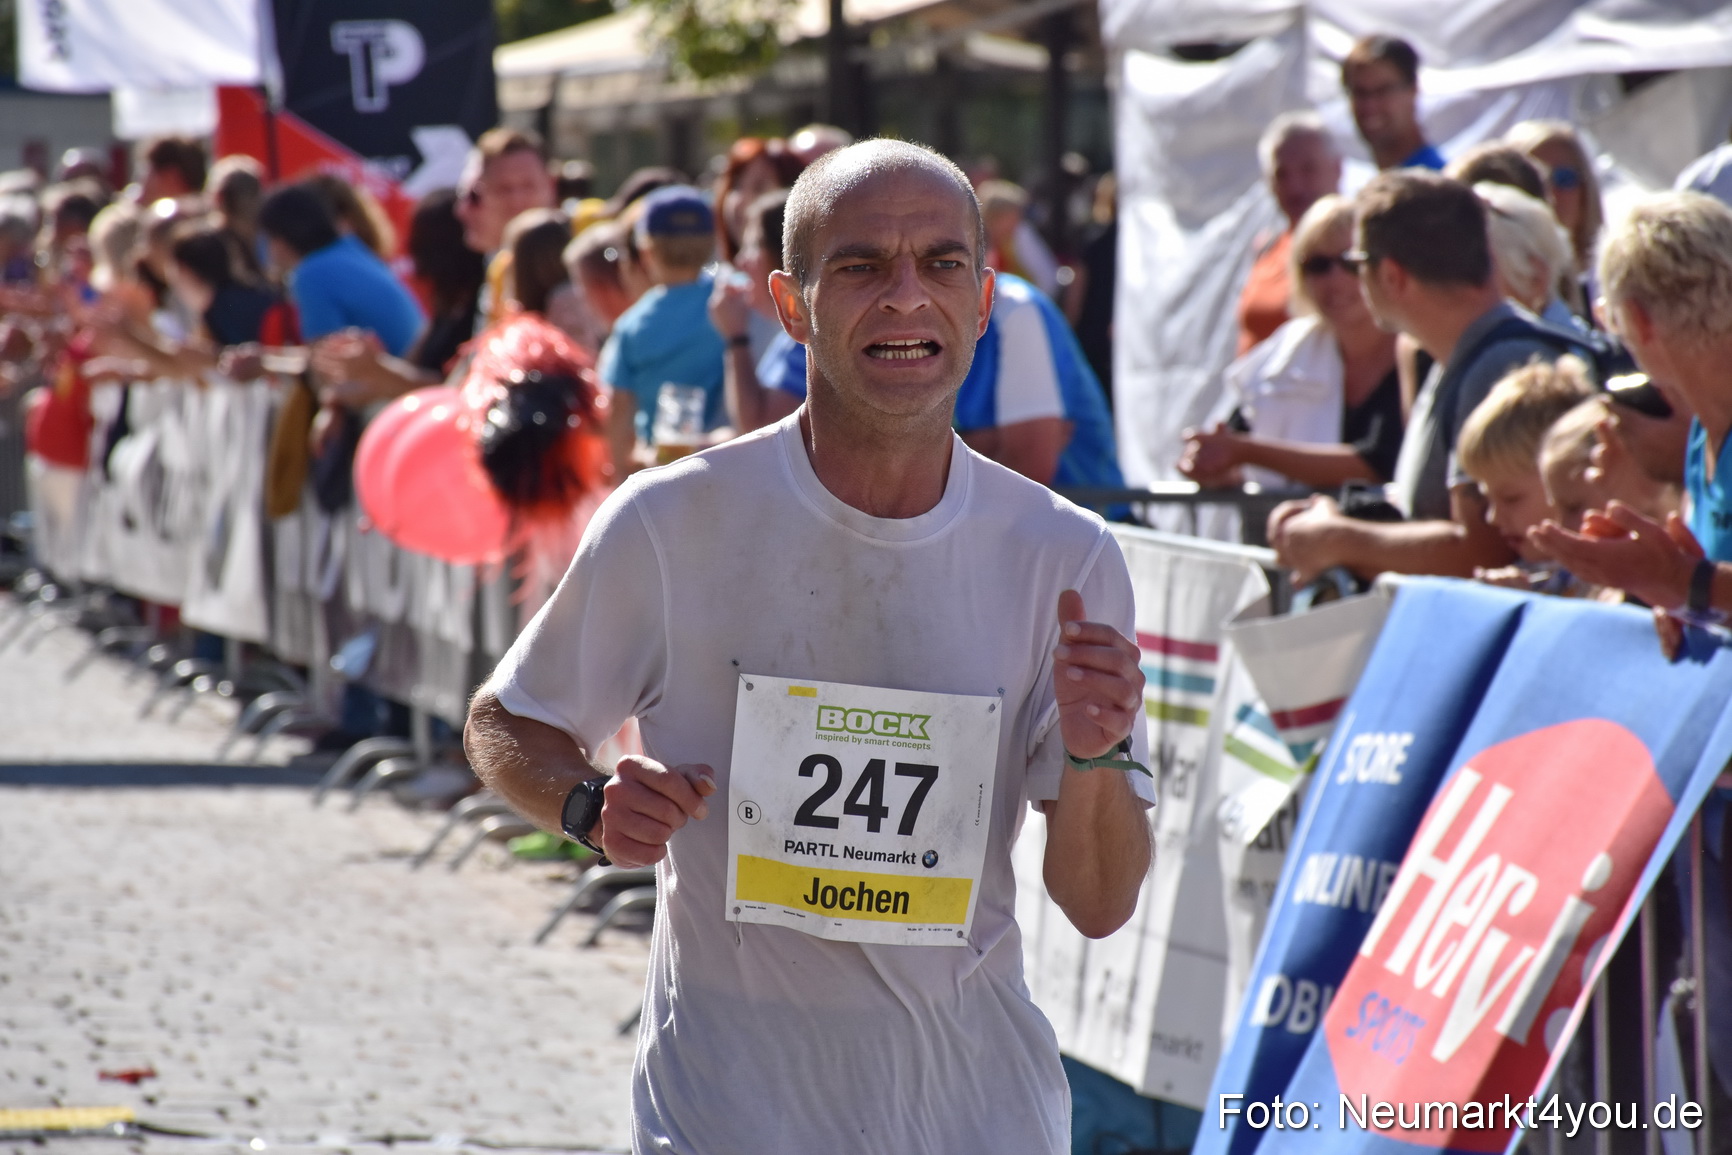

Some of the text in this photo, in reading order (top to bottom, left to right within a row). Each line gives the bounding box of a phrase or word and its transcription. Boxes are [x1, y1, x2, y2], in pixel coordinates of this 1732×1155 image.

[815, 731, 931, 750] inspired by smart concepts
[816, 705, 932, 741] BOCK
[1336, 731, 1414, 785] STORE
[745, 806, 753, 819] B
[793, 753, 939, 836] 247
[784, 839, 838, 858] PARTL
[843, 845, 916, 864] Neumarkt
[803, 877, 910, 915] Jochen
[1358, 764, 1612, 1063] Hervi
